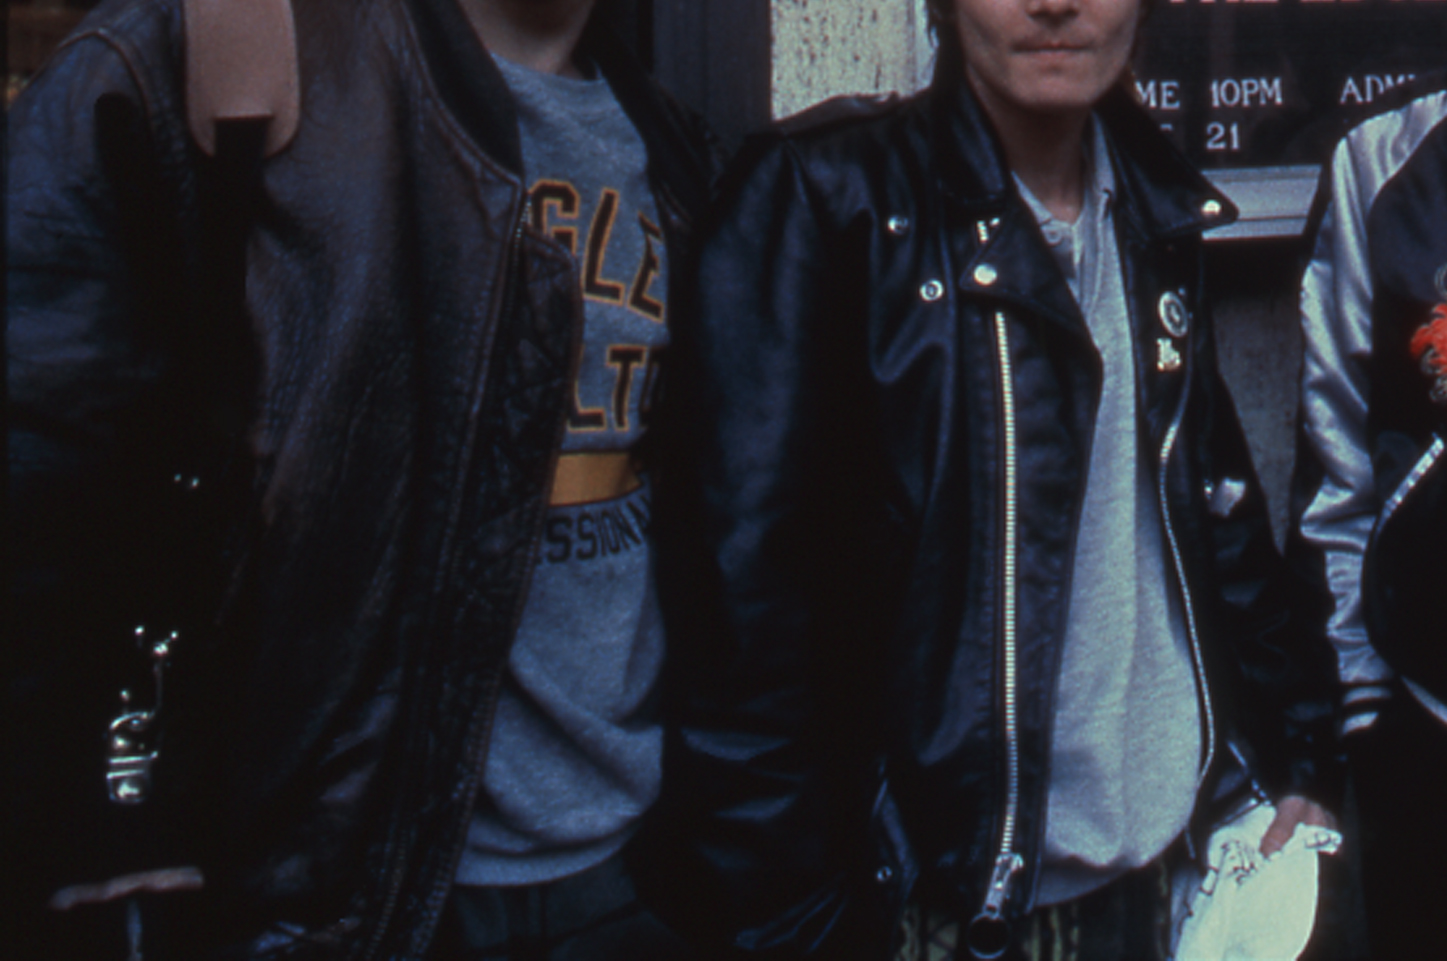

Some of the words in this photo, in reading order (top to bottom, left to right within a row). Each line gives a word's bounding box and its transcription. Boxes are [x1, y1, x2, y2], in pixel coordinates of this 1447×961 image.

[1134, 79, 1181, 111] ME
[1205, 121, 1240, 151] 21
[527, 178, 664, 324] GLE
